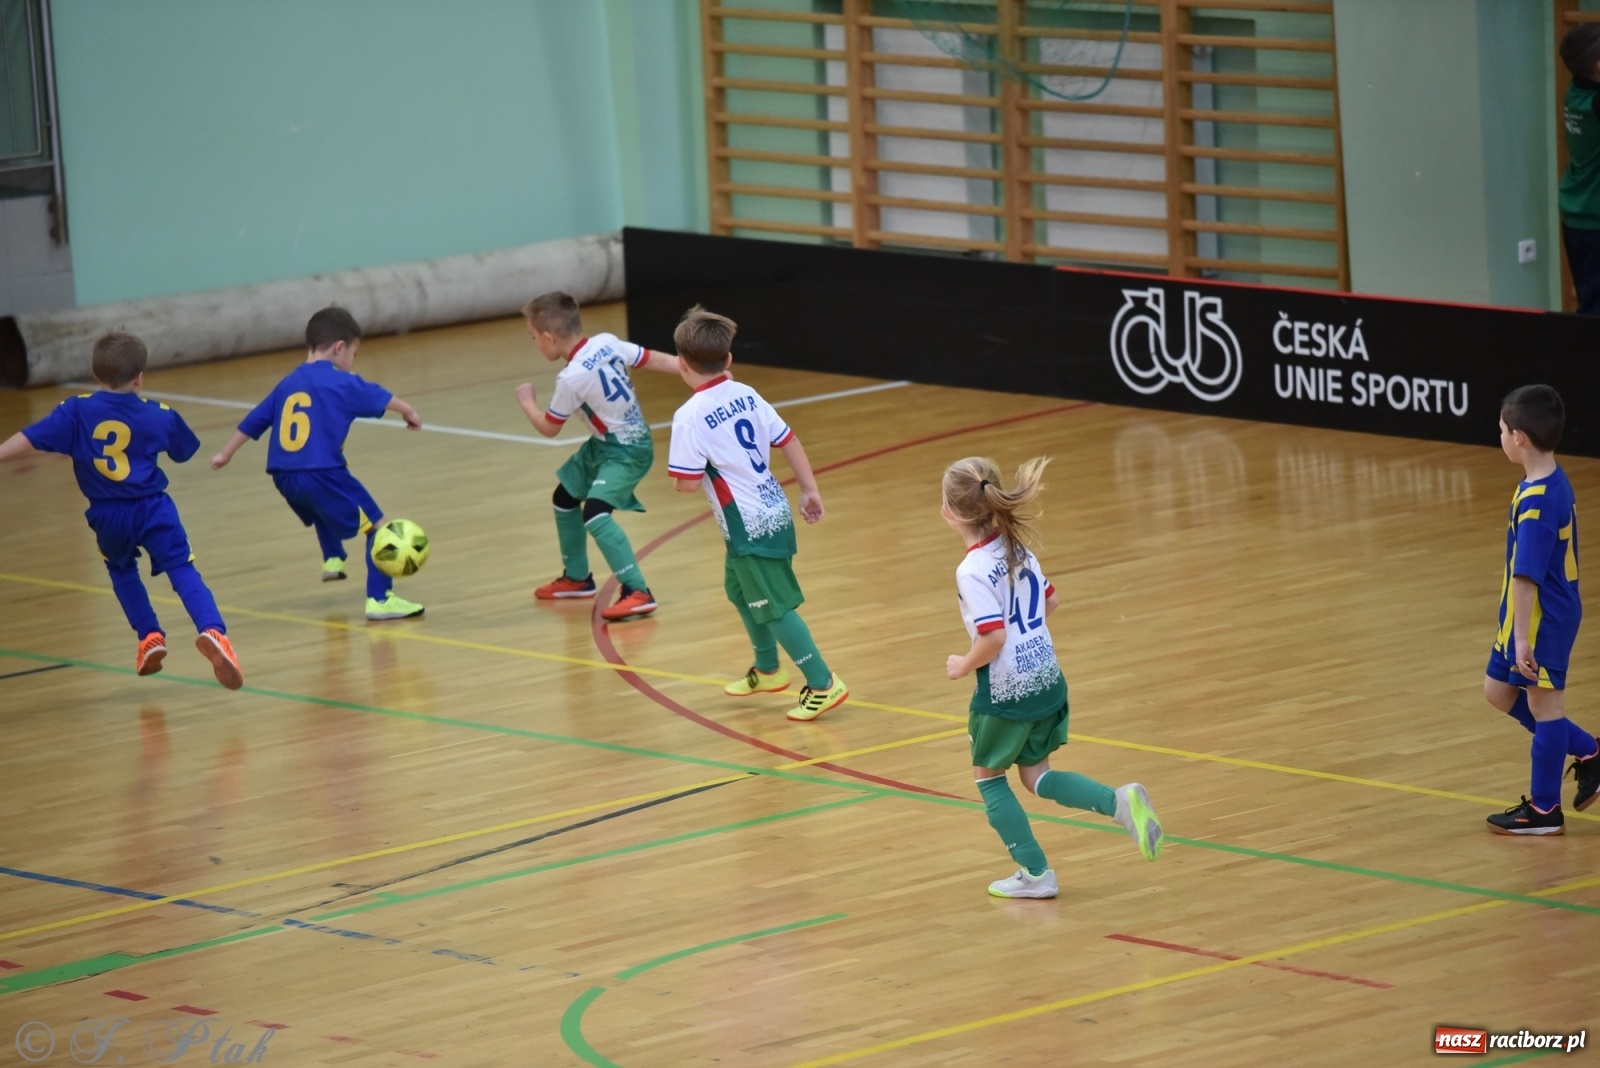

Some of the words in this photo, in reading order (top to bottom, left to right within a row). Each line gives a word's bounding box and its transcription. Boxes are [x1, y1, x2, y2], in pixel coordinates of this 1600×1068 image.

[1272, 311, 1370, 362] ČESKÁ
[704, 397, 747, 430] BIELAN
[1274, 363, 1344, 405] UNIE
[1351, 371, 1469, 417] SPORTU
[92, 419, 132, 482] 3
[279, 391, 312, 453] 6
[1558, 503, 1579, 582] 1
[1008, 567, 1043, 635] 42
